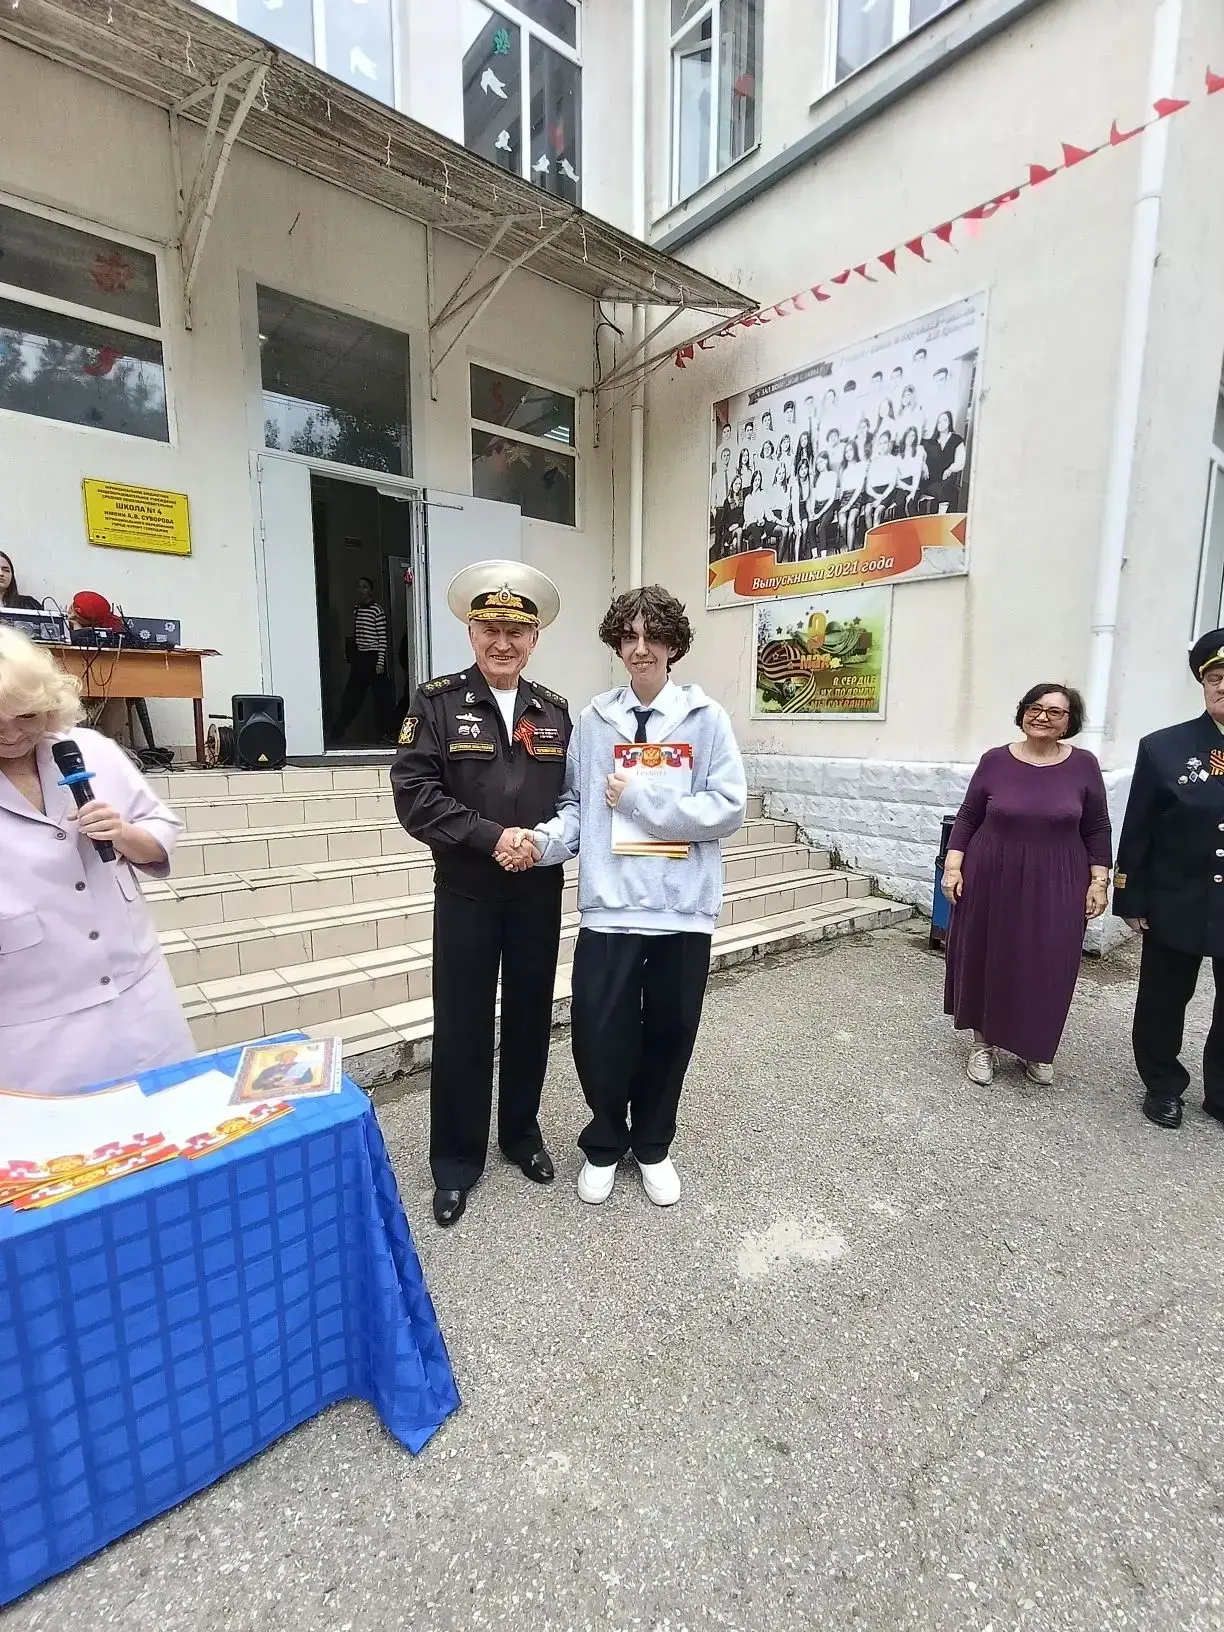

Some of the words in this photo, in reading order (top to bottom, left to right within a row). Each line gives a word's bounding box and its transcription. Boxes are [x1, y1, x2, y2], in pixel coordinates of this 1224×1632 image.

[115, 502, 146, 513] ШКОЛА
[127, 512, 140, 520] А.В.
[141, 514, 174, 525] СУВОРОВА
[752, 569, 825, 591] Выпускники
[824, 560, 859, 578] 2021
[860, 555, 895, 573] года
[832, 676, 839, 686] В
[841, 674, 876, 686] СЕРДЦЕ
[820, 688, 832, 697] ИХ
[834, 686, 875, 697] ПОДВИГИ
